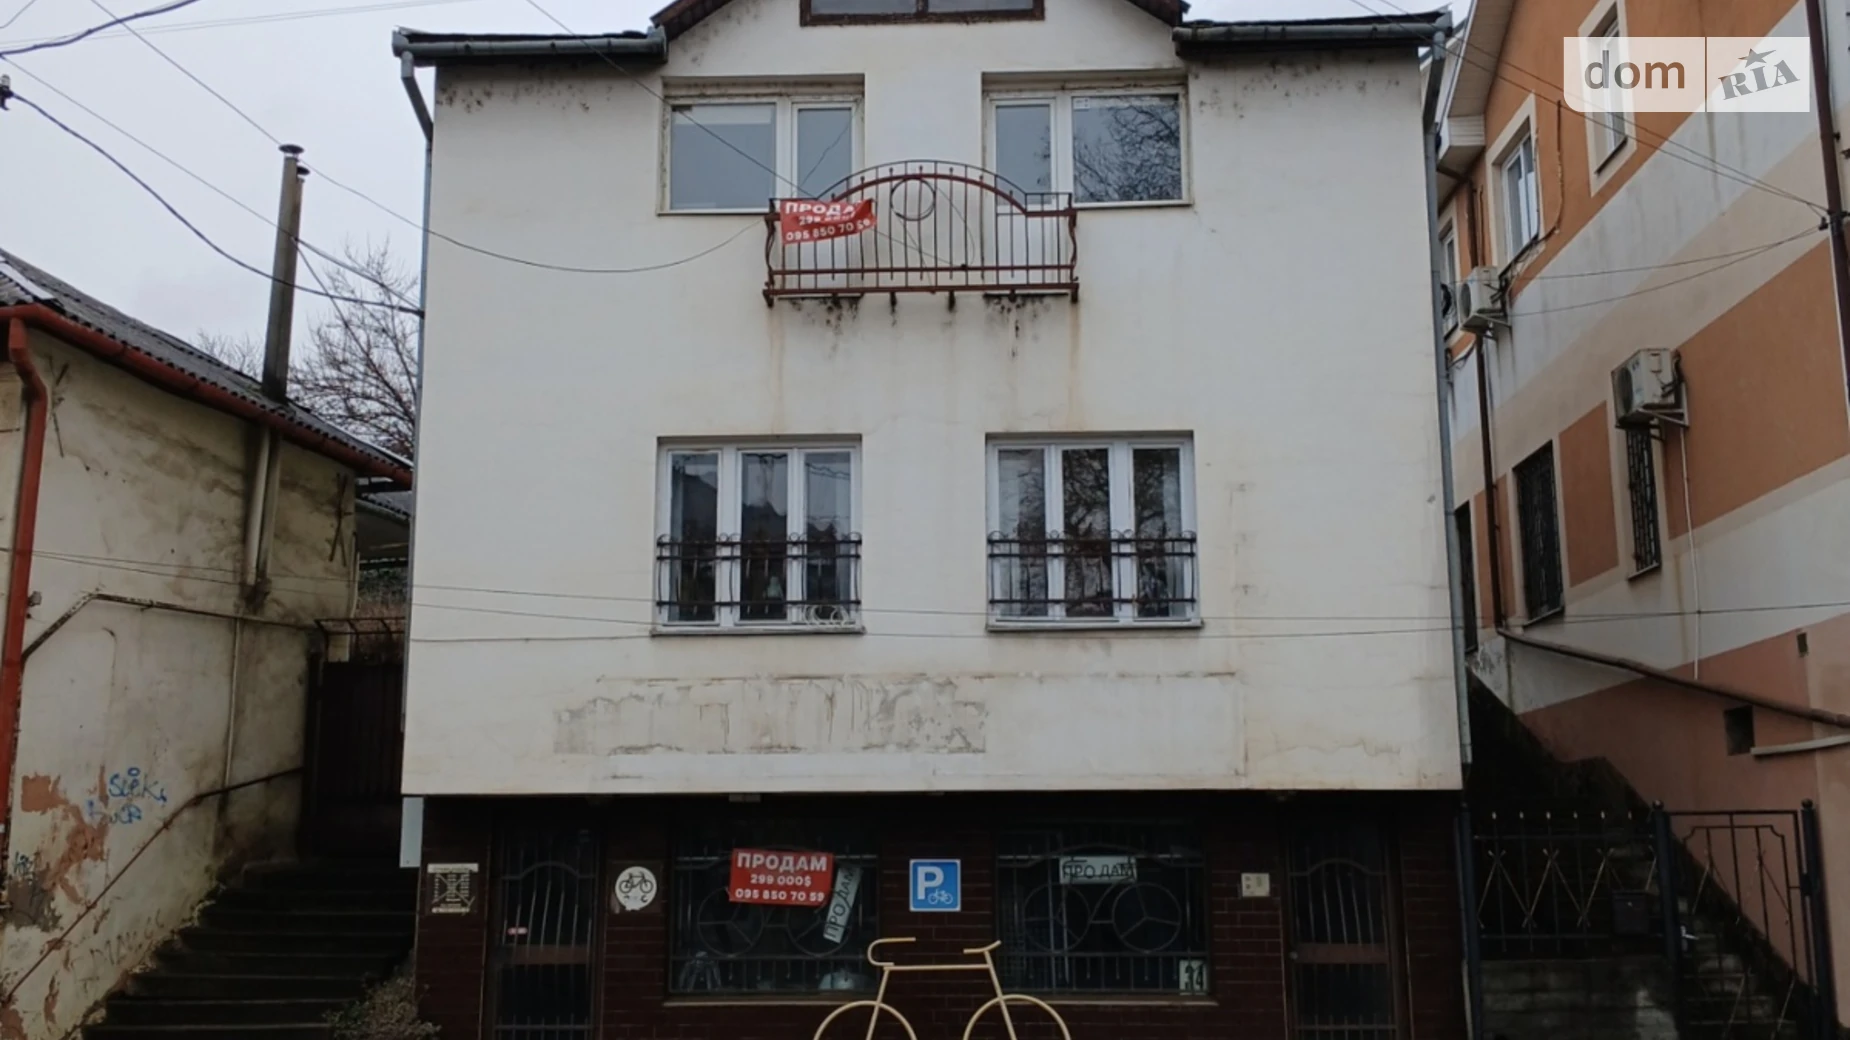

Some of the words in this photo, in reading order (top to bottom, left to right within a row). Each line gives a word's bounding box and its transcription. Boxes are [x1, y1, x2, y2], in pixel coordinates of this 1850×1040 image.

[785, 202, 856, 218] ПРОДА
[786, 230, 810, 241] 095
[812, 225, 835, 238] 850
[837, 222, 854, 233] 70
[737, 852, 827, 873] ПРОДАМ
[750, 874, 774, 885] 299
[777, 875, 812, 887] 000$
[917, 866, 944, 899] P
[735, 888, 759, 899] 095
[762, 890, 787, 900] 850
[790, 891, 806, 901] 70
[809, 892, 825, 902] 59
